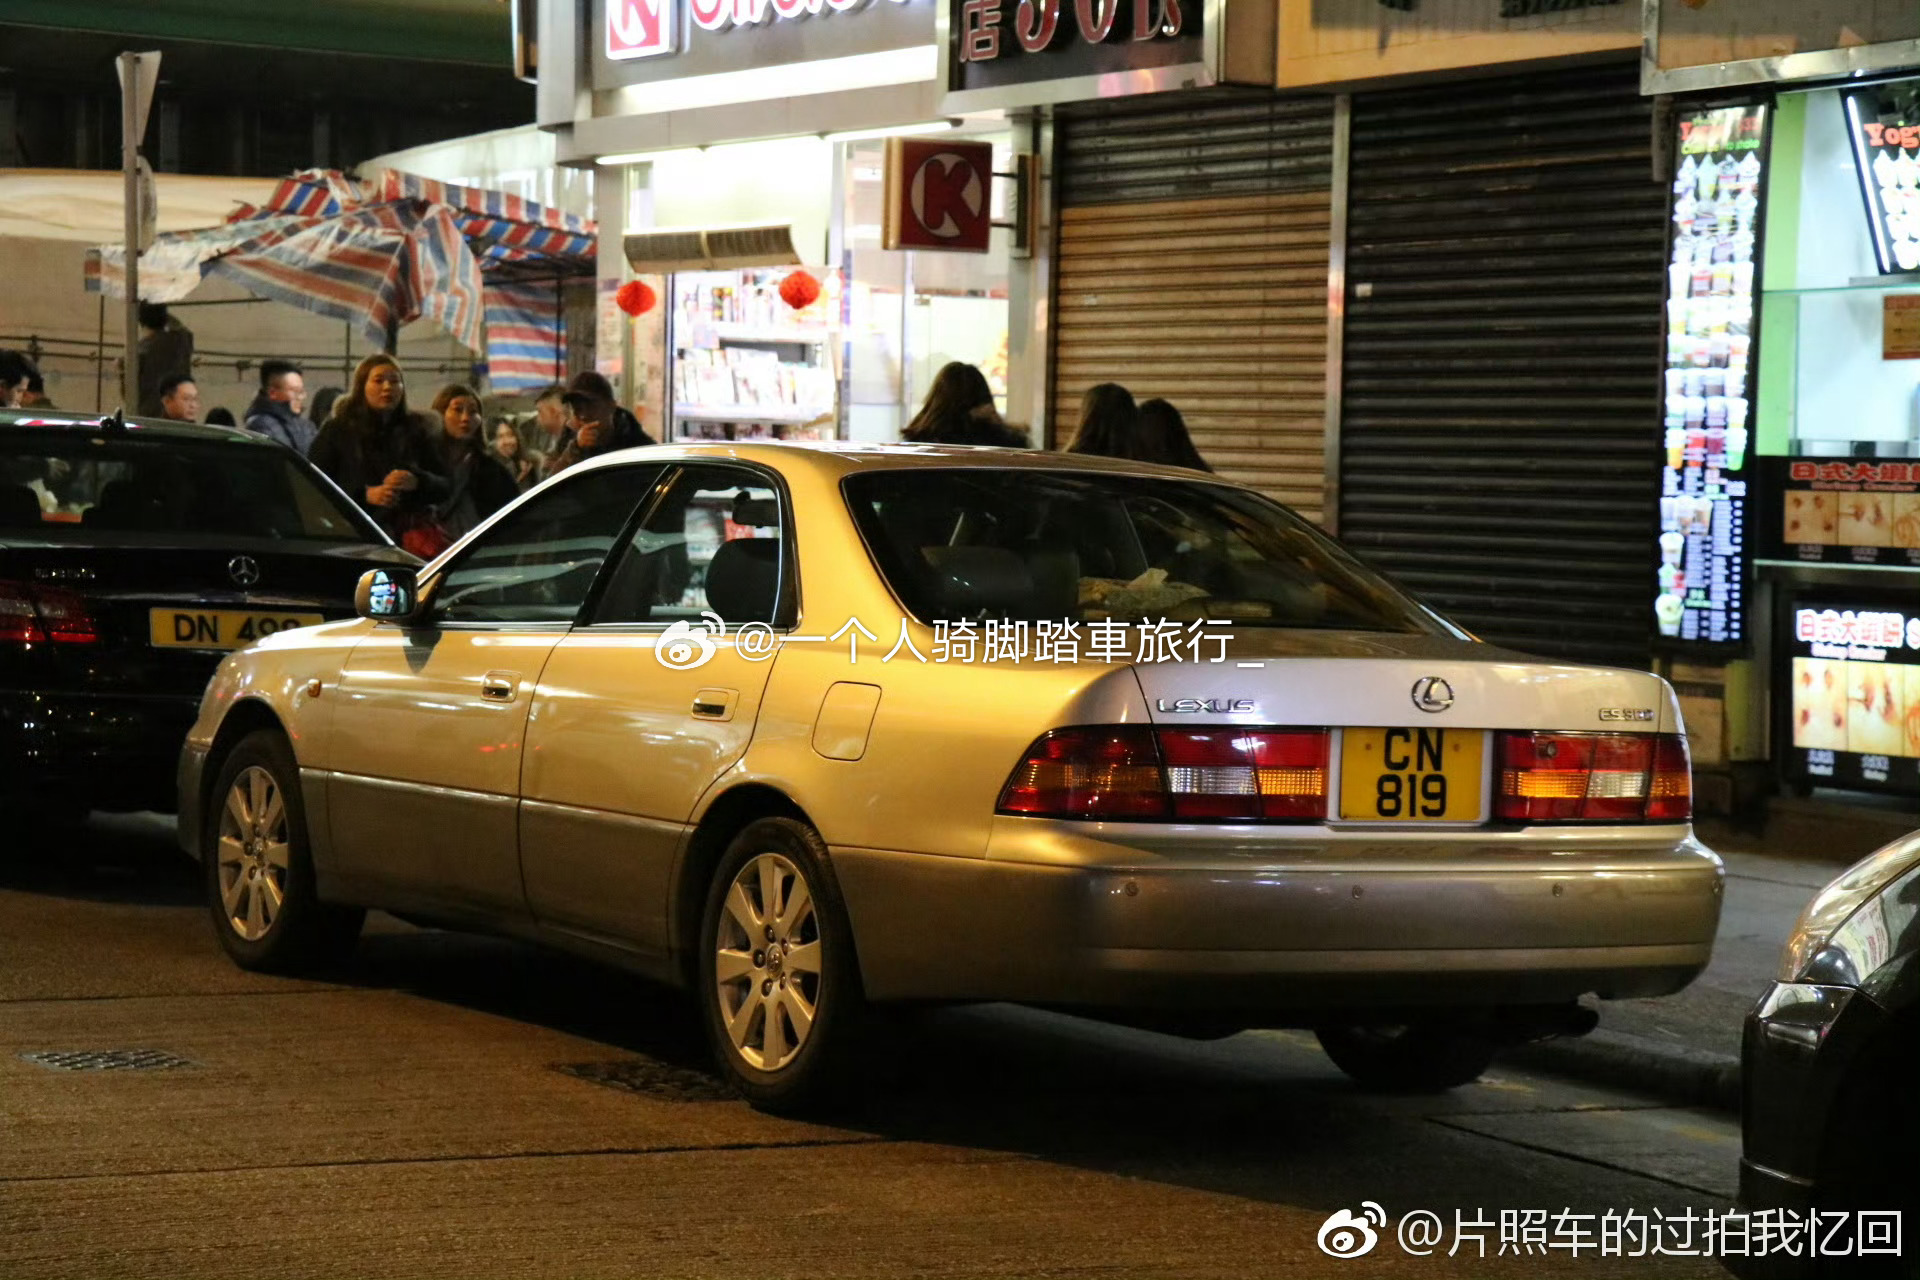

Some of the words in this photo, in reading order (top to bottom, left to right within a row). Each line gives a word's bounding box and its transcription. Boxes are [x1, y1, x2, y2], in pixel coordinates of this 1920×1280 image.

[1863, 123, 1920, 148] Yog
[915, 154, 981, 238] K
[174, 614, 219, 643] DN
[1157, 699, 1255, 714] LEXUS
[1384, 728, 1444, 771] CN
[1377, 774, 1446, 818] 819
